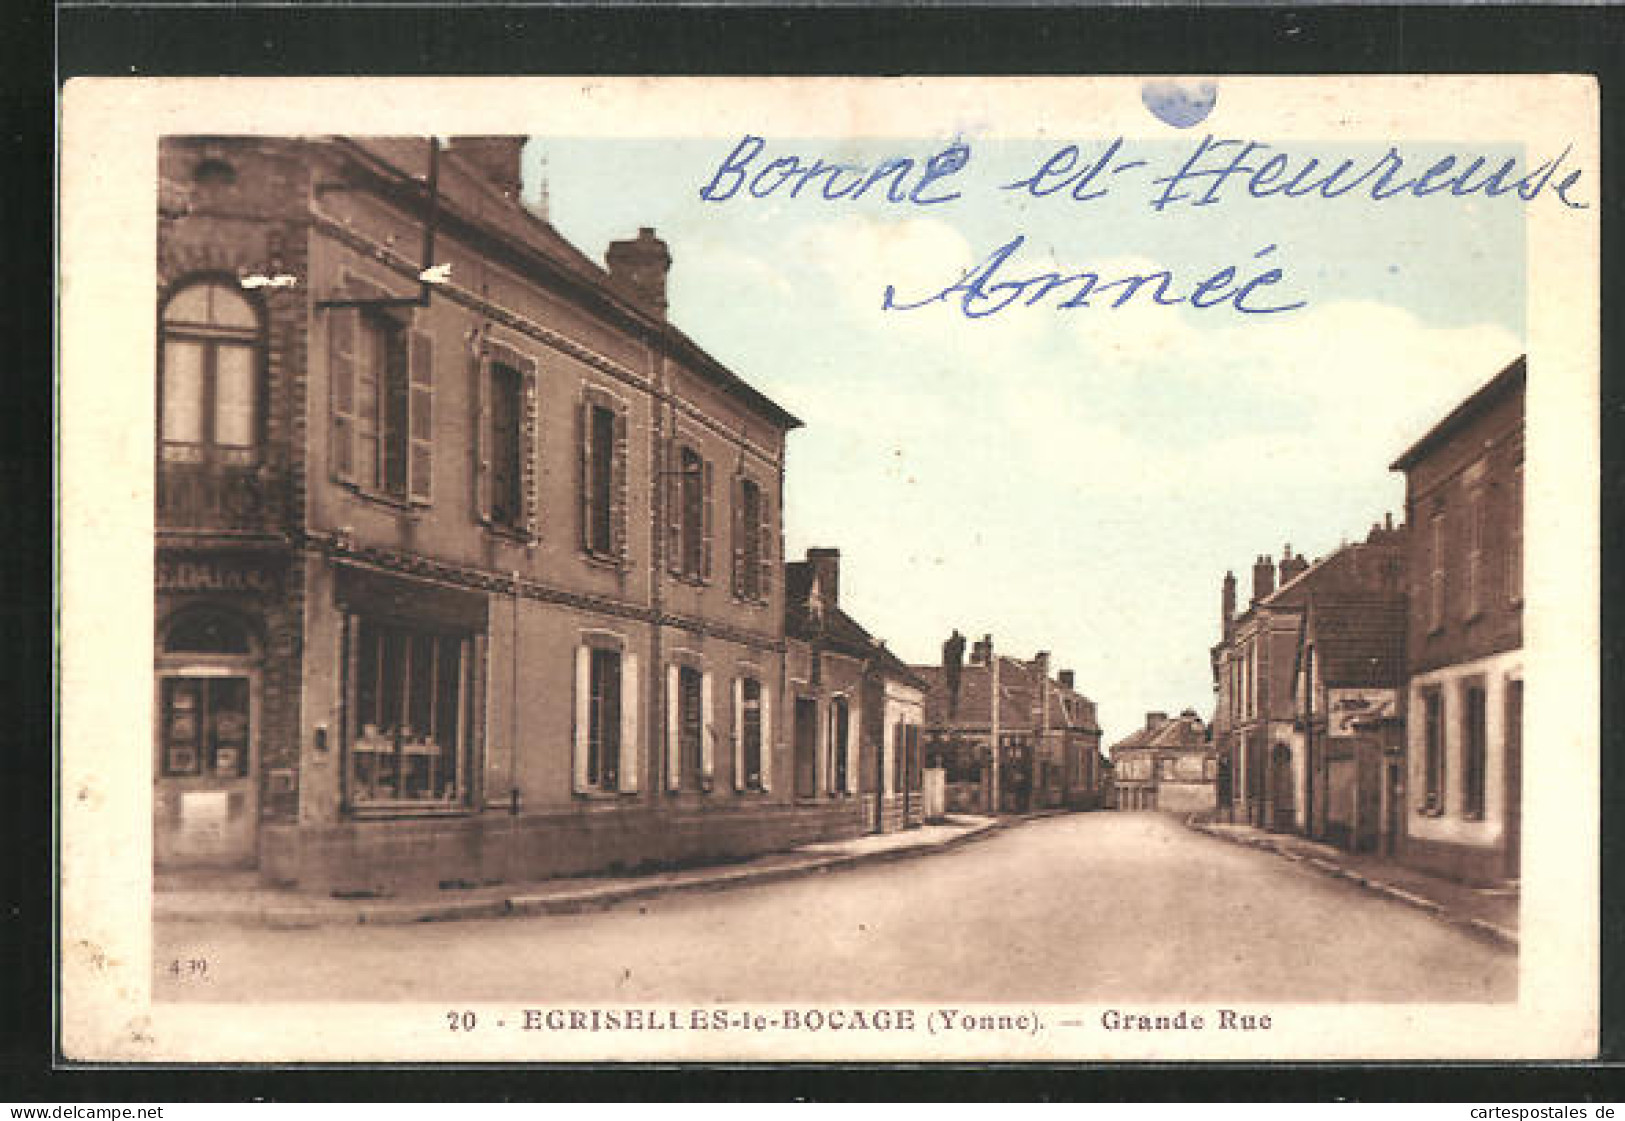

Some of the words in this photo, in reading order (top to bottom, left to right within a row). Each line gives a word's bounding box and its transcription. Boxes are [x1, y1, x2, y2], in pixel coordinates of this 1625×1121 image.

[1000, 137, 1146, 201] et
[1151, 135, 1590, 211] Heureuse
[882, 235, 1306, 319] Année
[446, 1009, 476, 1032] 20
[1101, 1009, 1205, 1032] Grande
[1218, 1009, 1273, 1031] Rue
